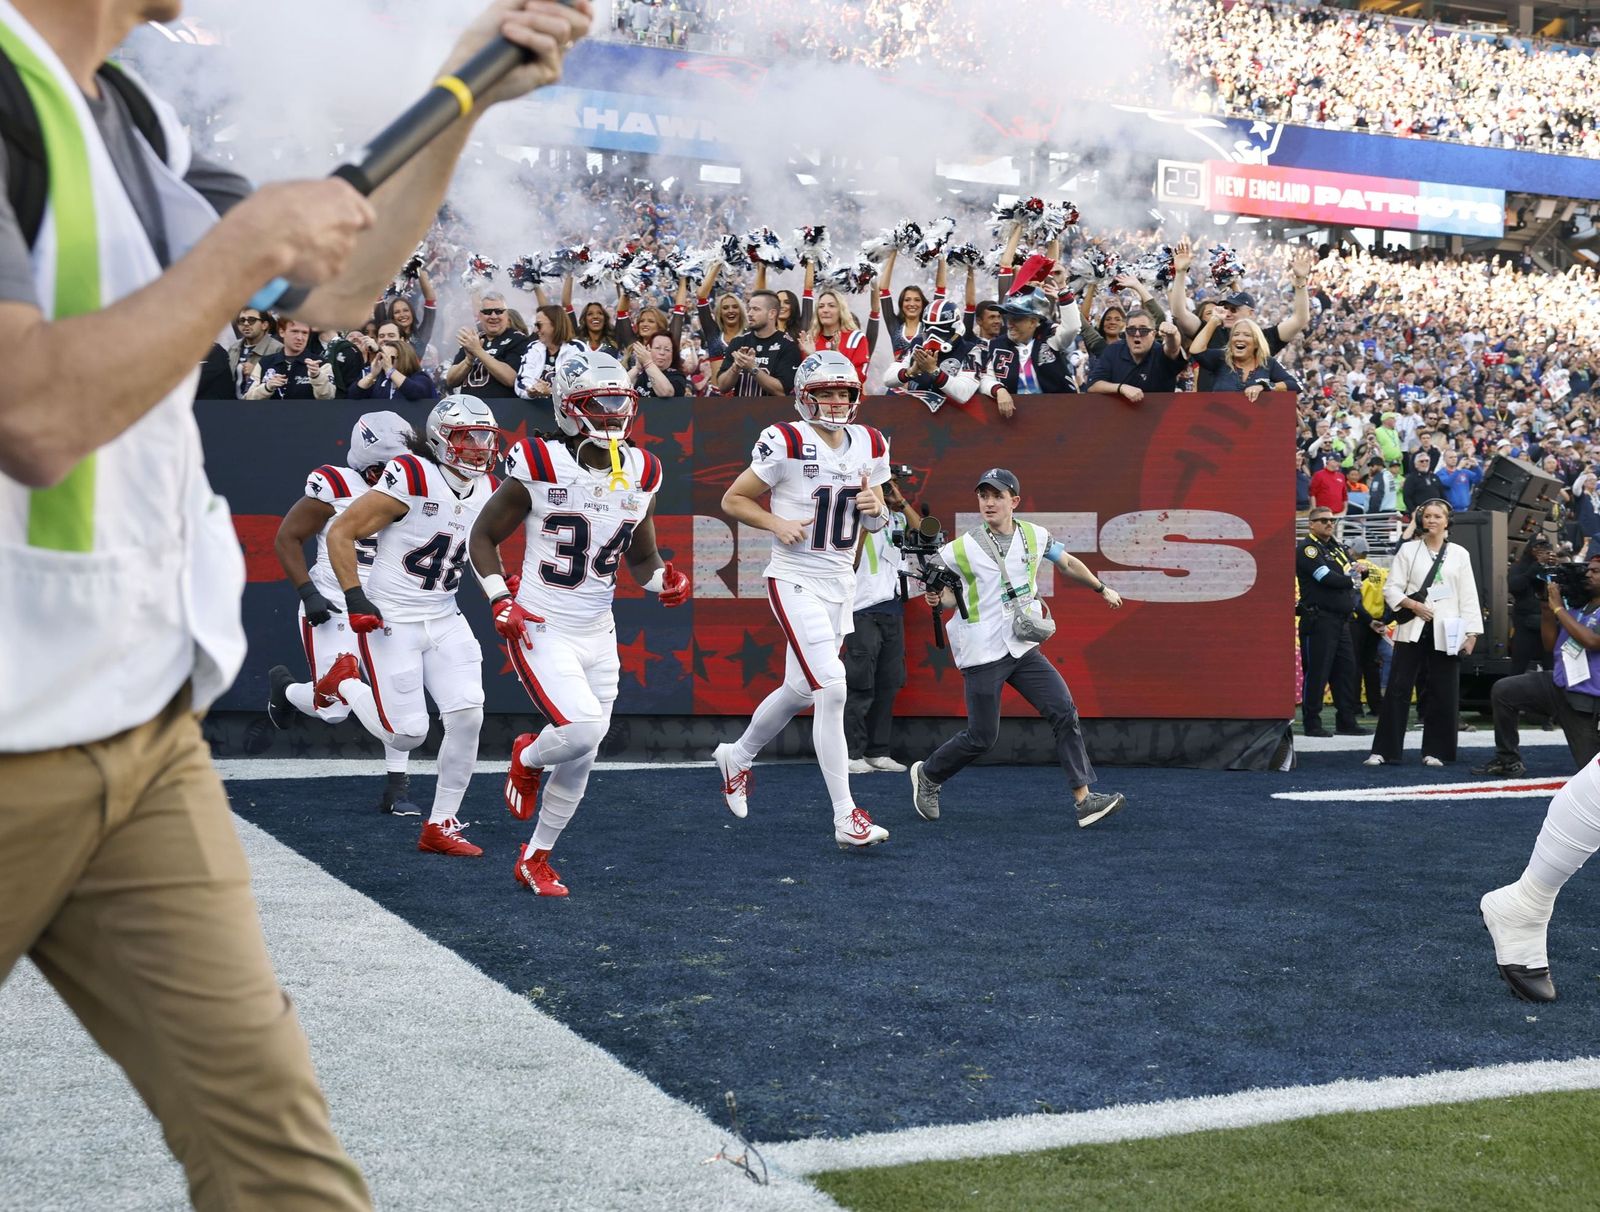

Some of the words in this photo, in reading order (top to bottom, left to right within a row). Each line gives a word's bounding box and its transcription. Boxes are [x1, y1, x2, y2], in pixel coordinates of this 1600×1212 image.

[1166, 168, 1198, 197] 25
[1215, 175, 1247, 198] NEW
[1250, 178, 1311, 205] ENGLAND
[1314, 184, 1502, 225] PATRIOTS
[802, 445, 816, 456] C
[584, 502, 609, 512] PATRIOTS
[811, 485, 862, 551] 10
[538, 513, 638, 590] 34
